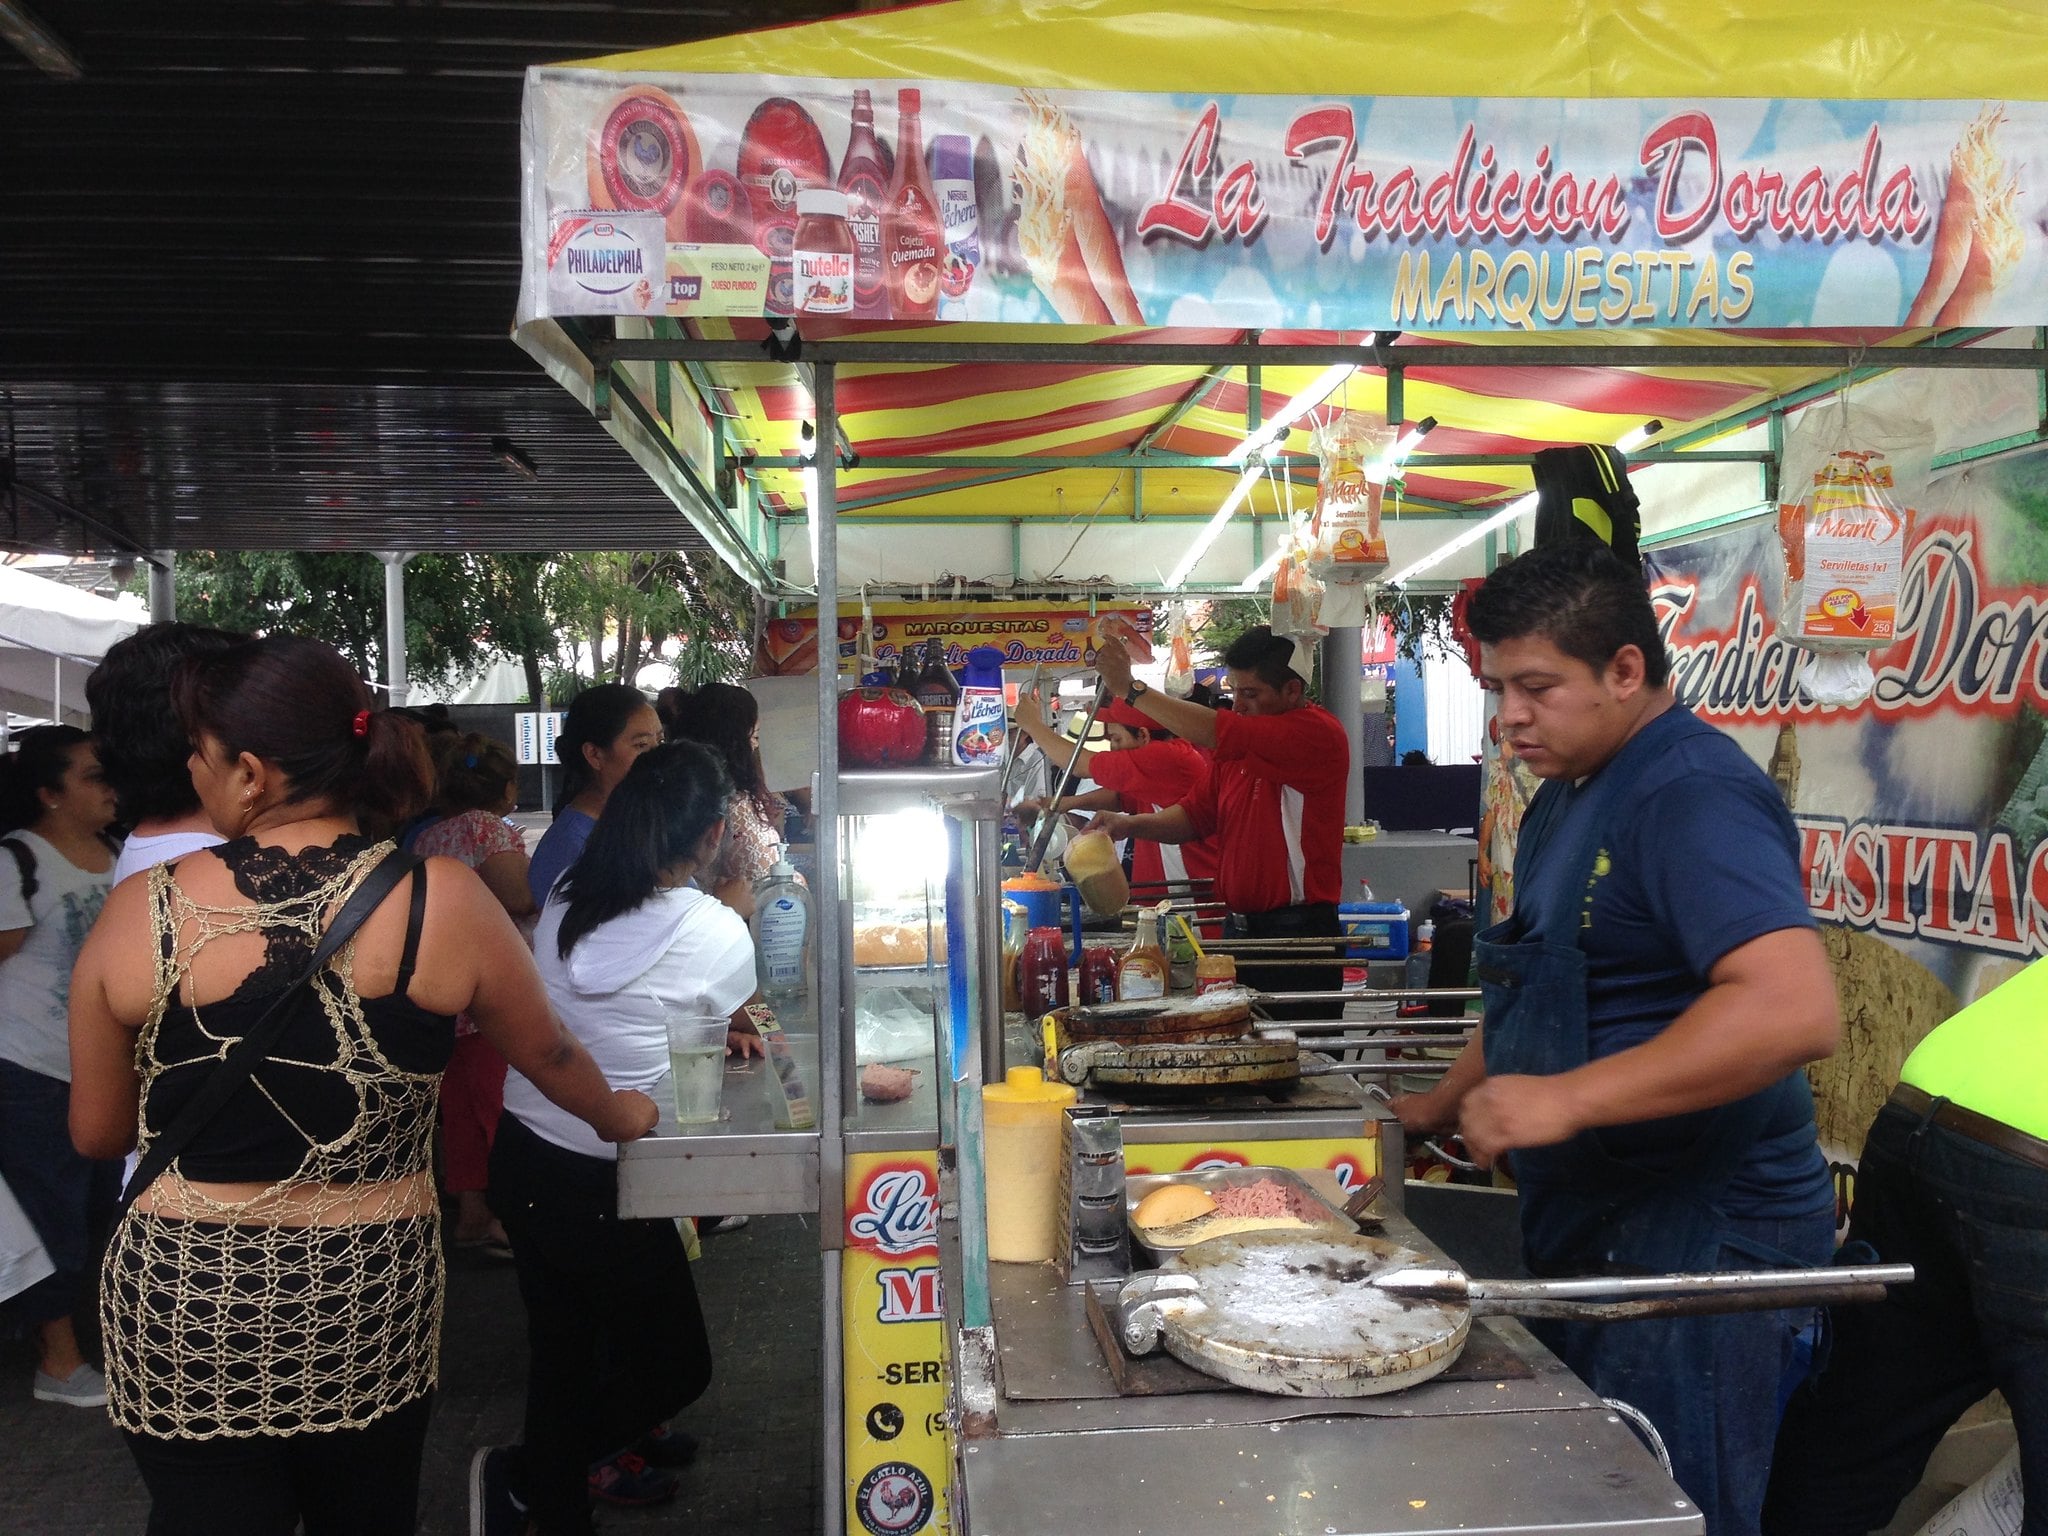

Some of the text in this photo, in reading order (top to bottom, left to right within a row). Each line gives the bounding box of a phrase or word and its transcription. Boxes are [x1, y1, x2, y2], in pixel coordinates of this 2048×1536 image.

[1137, 102, 1928, 244] La Tradicion Dorada
[944, 204, 977, 228] echera
[900, 235, 924, 247] Cajeta
[566, 247, 643, 274] PHILADELPHIA
[711, 262, 728, 271] PESO
[729, 262, 745, 271] NETO
[746, 262, 751, 271] 2
[801, 254, 849, 277] nutella
[891, 245, 936, 267] Quemada
[673, 281, 697, 297] top
[711, 281, 731, 290] QUESO
[1391, 249, 1756, 331] MARQUESITAS
[1816, 517, 1879, 541] Marli
[1820, 559, 1888, 573] Servilletas 1x1
[904, 619, 1050, 636] MARQUESITAS
[1874, 532, 2048, 705] Dor
[1874, 623, 1890, 633] 250
[1004, 639, 1082, 665] Dorada
[523, 715, 531, 760] infinitum
[546, 716, 554, 761] infinitum
[853, 1173, 929, 1246] La
[860, 1486, 872, 1500] EL
[908, 1471, 928, 1499] AZUL
